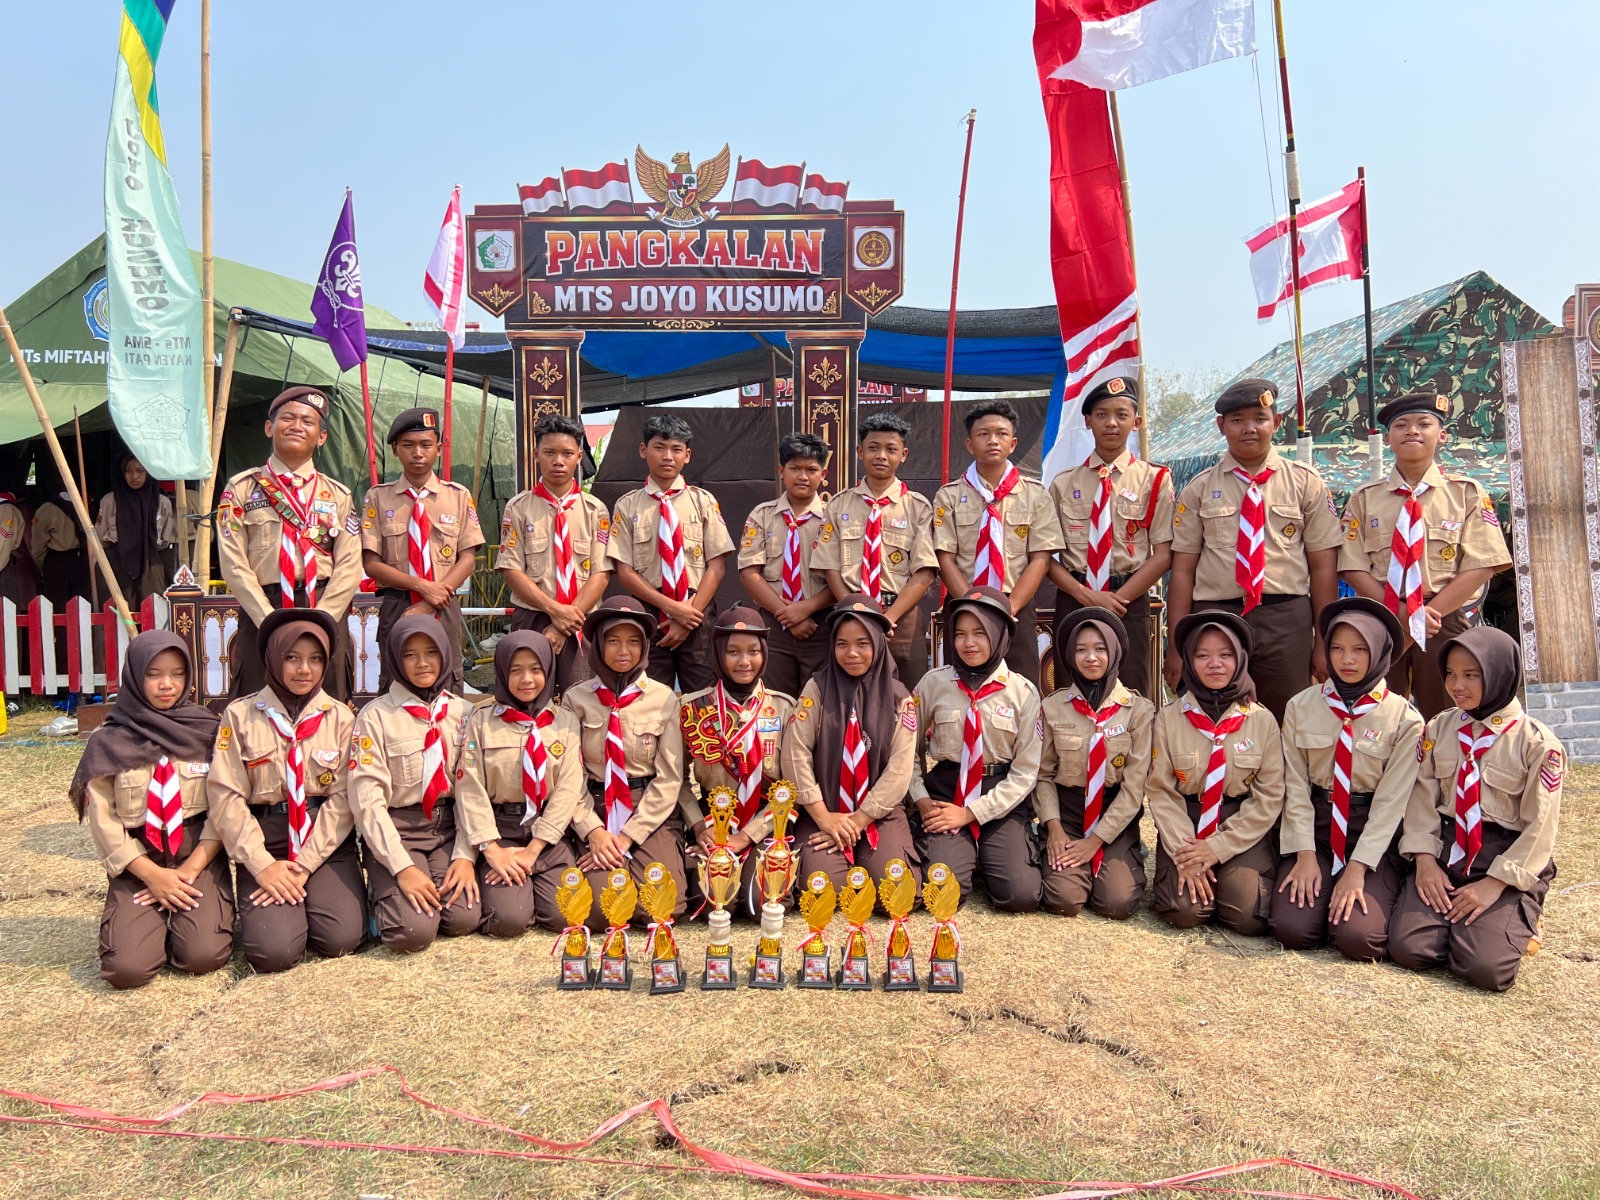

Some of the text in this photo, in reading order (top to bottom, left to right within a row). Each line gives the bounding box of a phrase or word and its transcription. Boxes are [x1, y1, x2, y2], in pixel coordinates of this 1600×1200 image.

[545, 229, 825, 276] PANGKALAN
[554, 285, 824, 312] MTS JOYO KUSUMO
